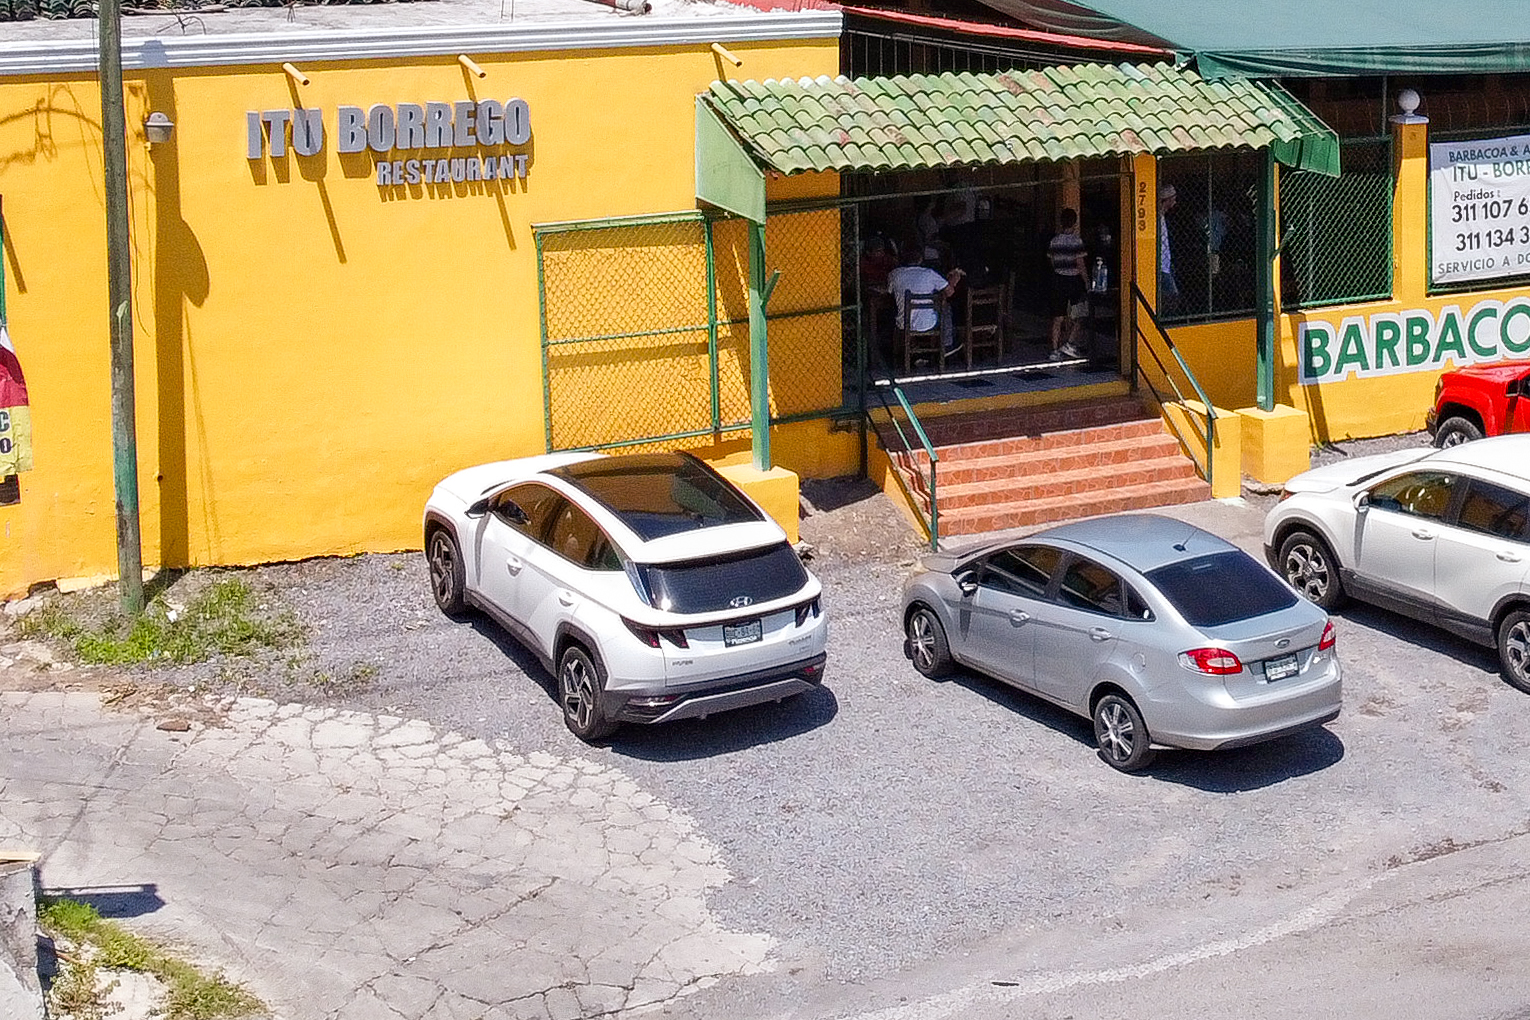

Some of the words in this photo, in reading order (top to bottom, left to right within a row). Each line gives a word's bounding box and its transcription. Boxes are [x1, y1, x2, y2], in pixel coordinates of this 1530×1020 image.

[246, 108, 323, 159] ITU
[337, 98, 531, 153] BORREGO
[1448, 146, 1508, 163] BARBACOA
[1510, 146, 1518, 156] &
[376, 154, 529, 186] RESTAURANT
[1453, 163, 1478, 182] ITU
[1452, 203, 1477, 223] 311
[1482, 199, 1513, 219] 107
[1455, 232, 1480, 251] 311
[1486, 228, 1515, 247] 134
[1438, 257, 1495, 274] SERVICIO
[1502, 256, 1510, 267] A
